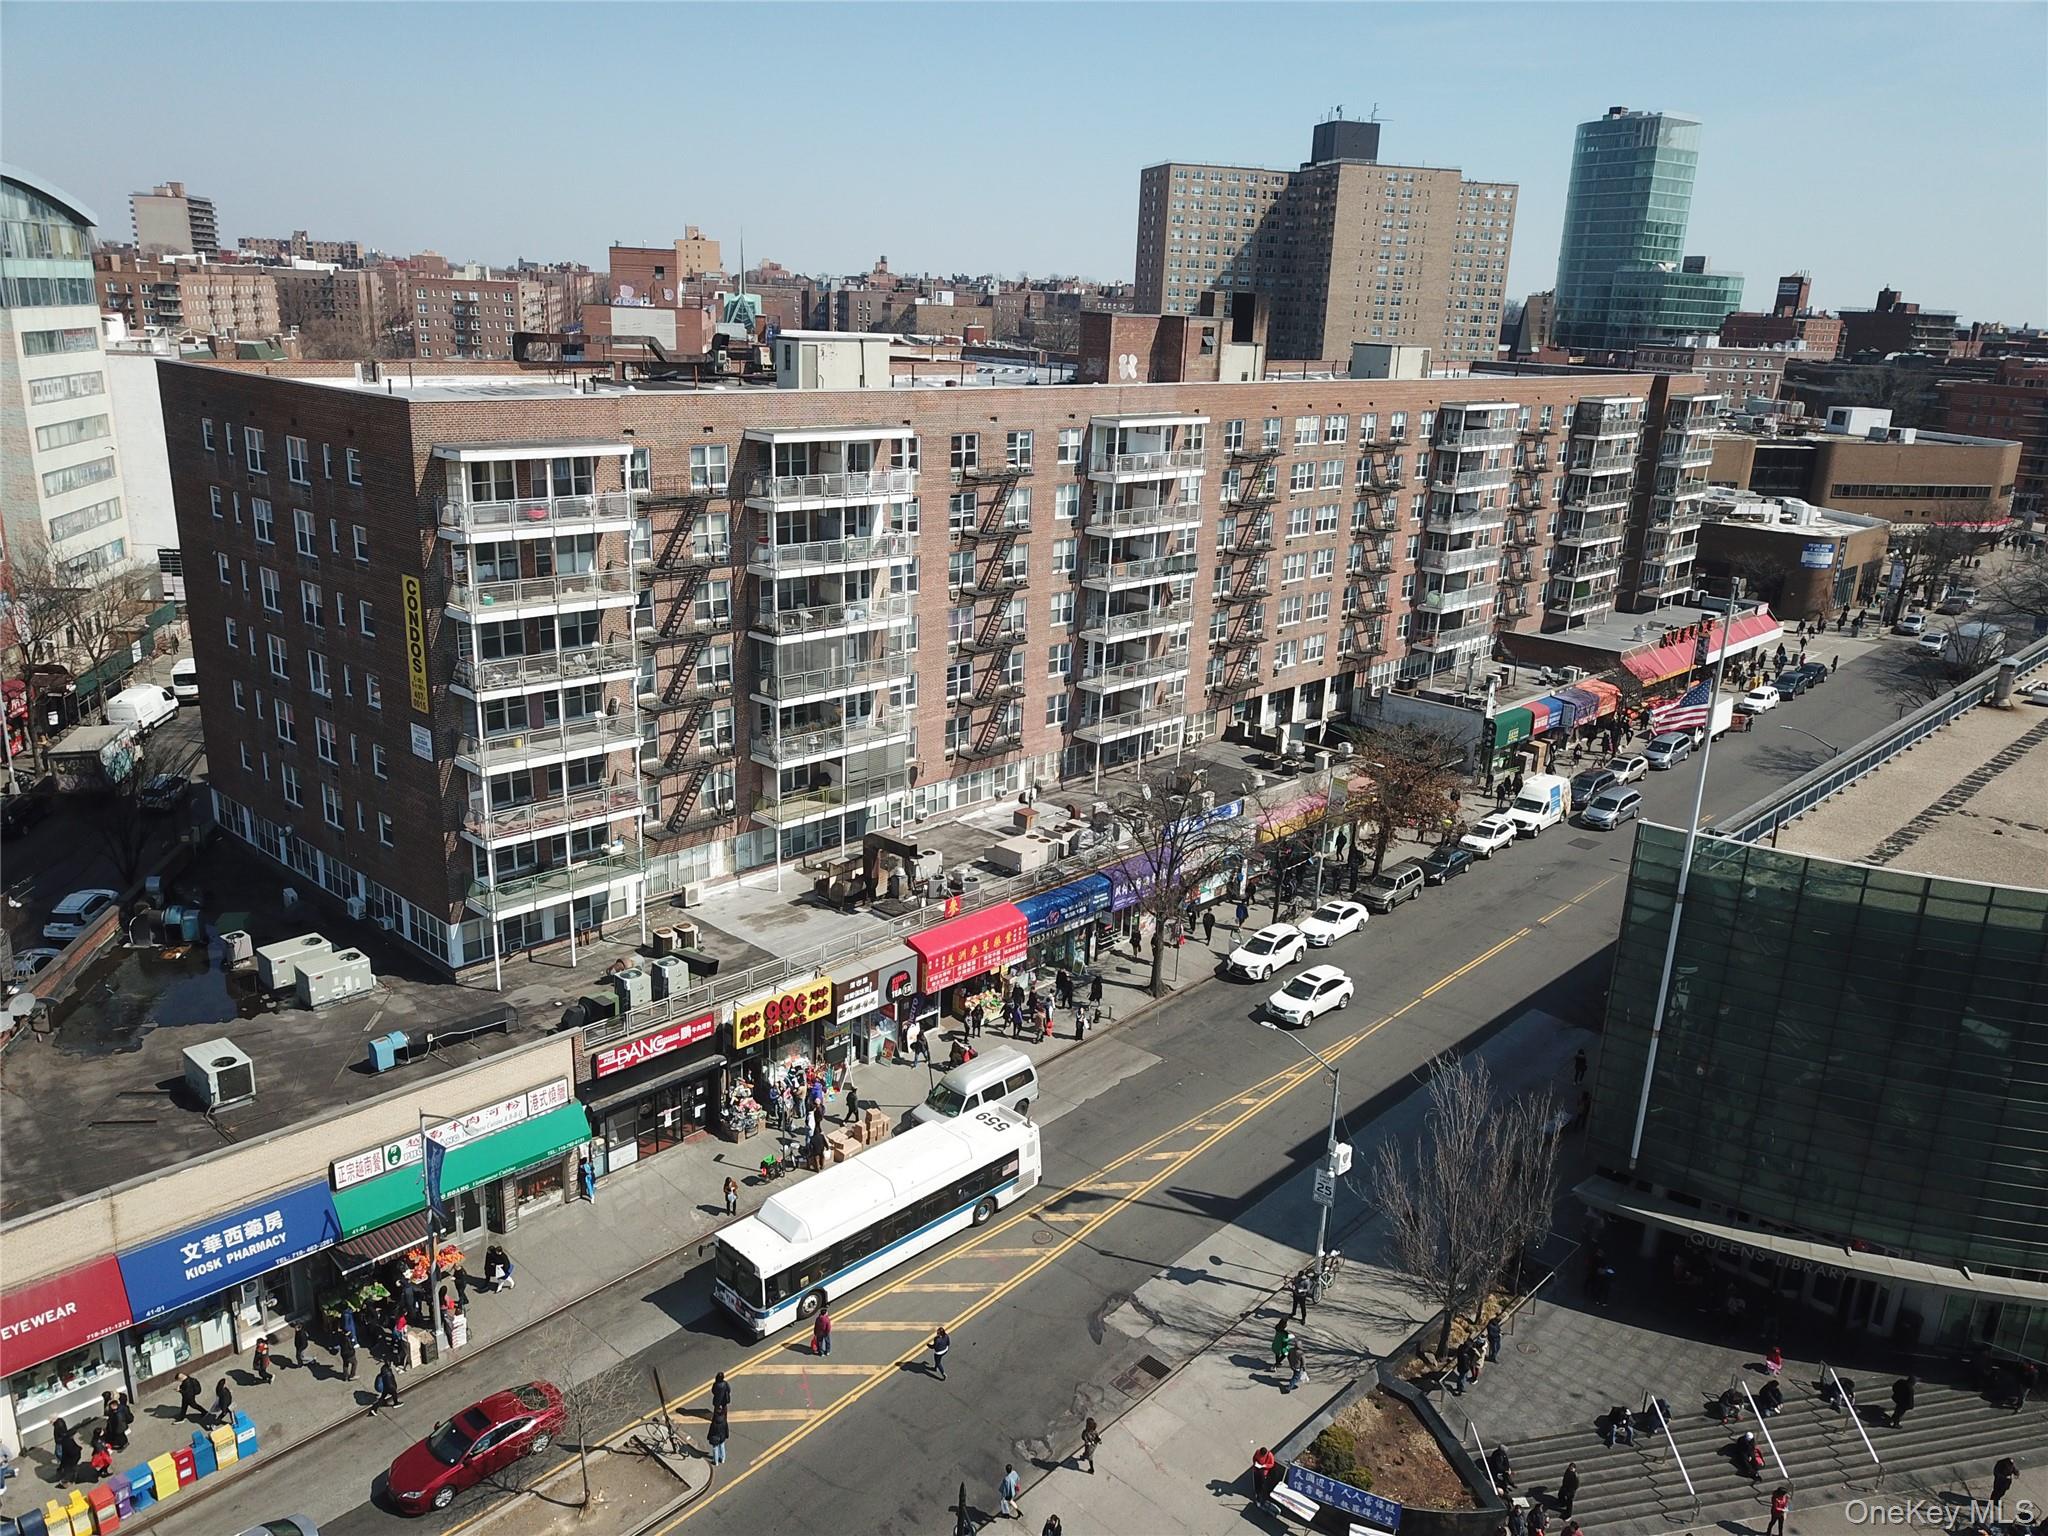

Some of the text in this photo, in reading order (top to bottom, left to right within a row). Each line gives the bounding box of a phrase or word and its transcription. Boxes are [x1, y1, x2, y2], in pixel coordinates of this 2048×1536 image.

[406, 579, 423, 674] CONDOS
[976, 1112, 1010, 1132] 559
[1316, 1182, 1332, 1196] 25
[180, 1210, 284, 1264] 文華西藥房
[185, 1232, 287, 1281] KIOSK PHARMACY
[1690, 1233, 1851, 1281] QUEENS LIBRARY
[1, 1302, 77, 1341] EYEWEAR
[145, 1304, 166, 1317] 41-01
